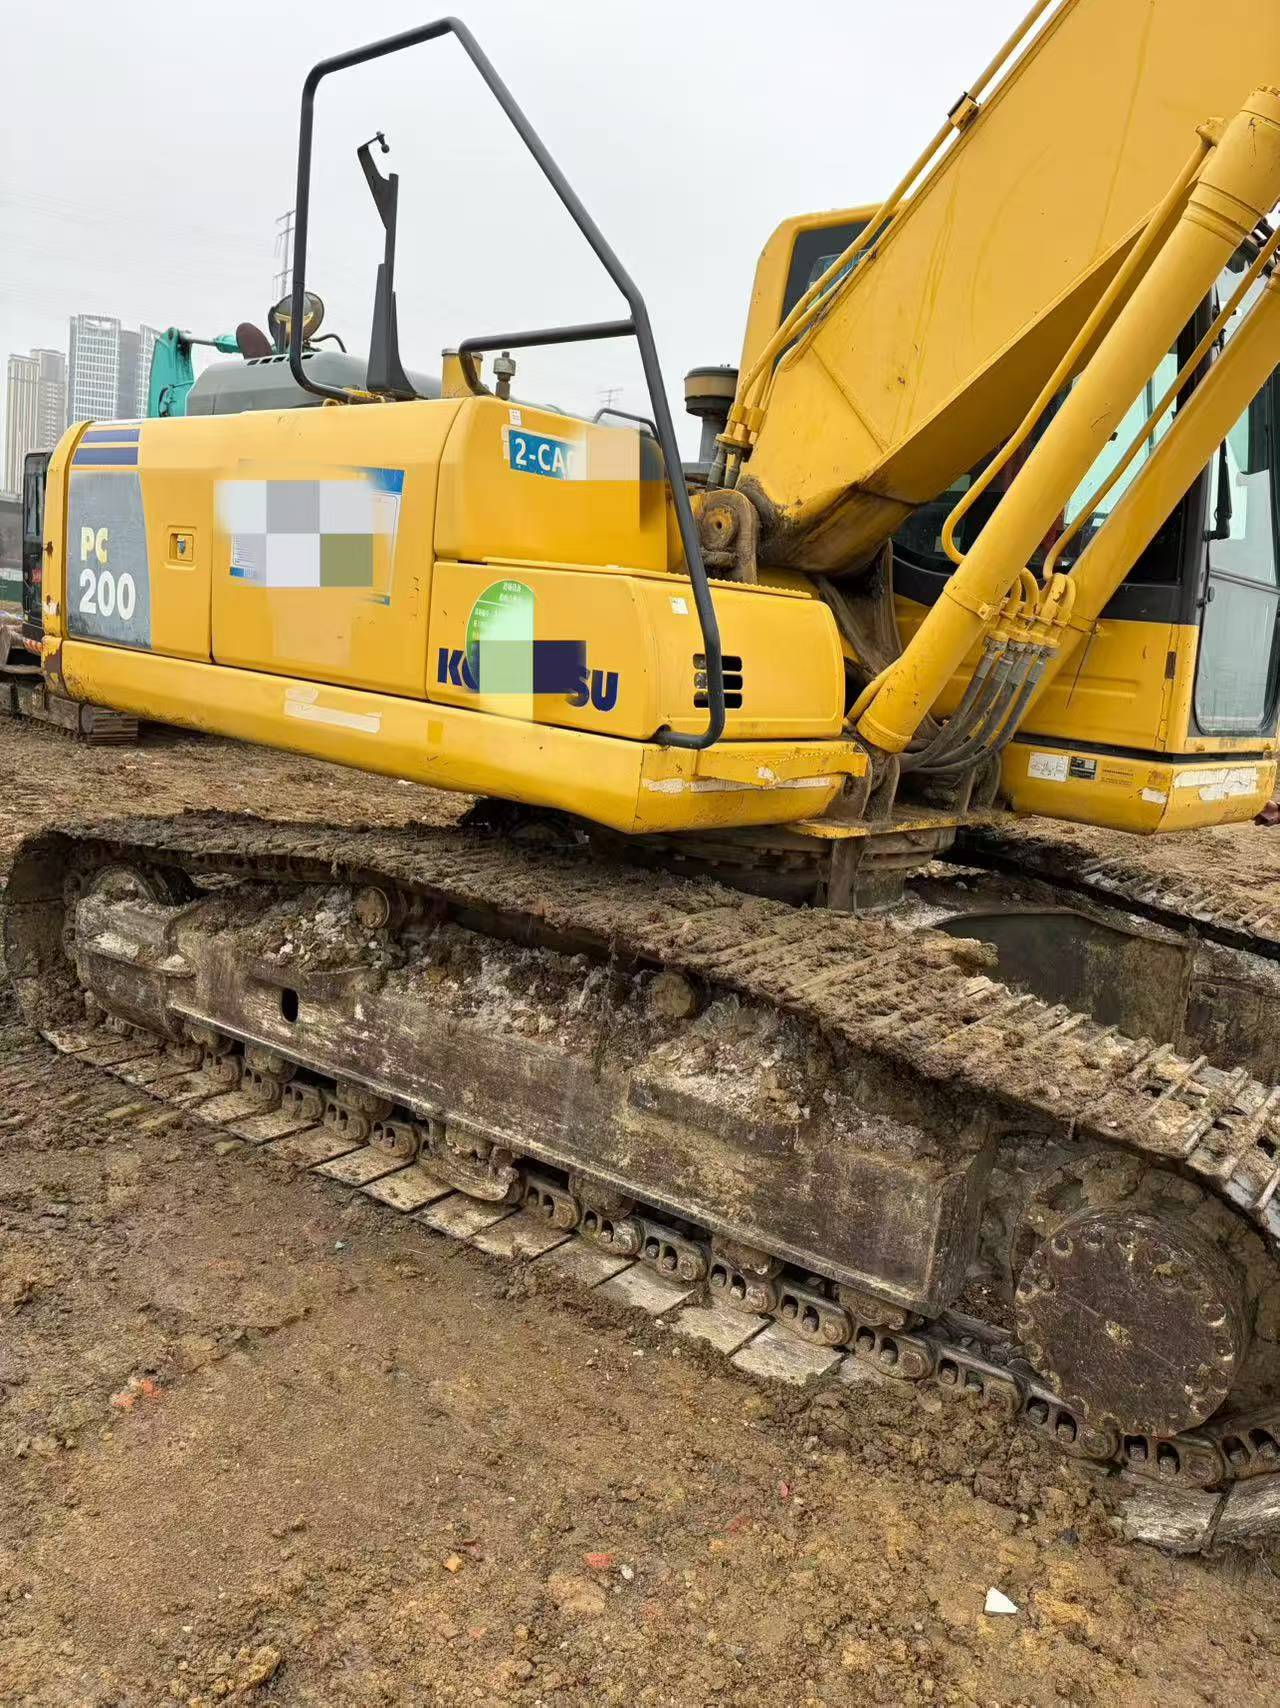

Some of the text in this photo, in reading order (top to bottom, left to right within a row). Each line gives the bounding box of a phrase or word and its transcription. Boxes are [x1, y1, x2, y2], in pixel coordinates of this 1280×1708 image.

[515, 438, 574, 480] 2-CA
[81, 527, 108, 563] PC
[80, 568, 135, 620] 200
